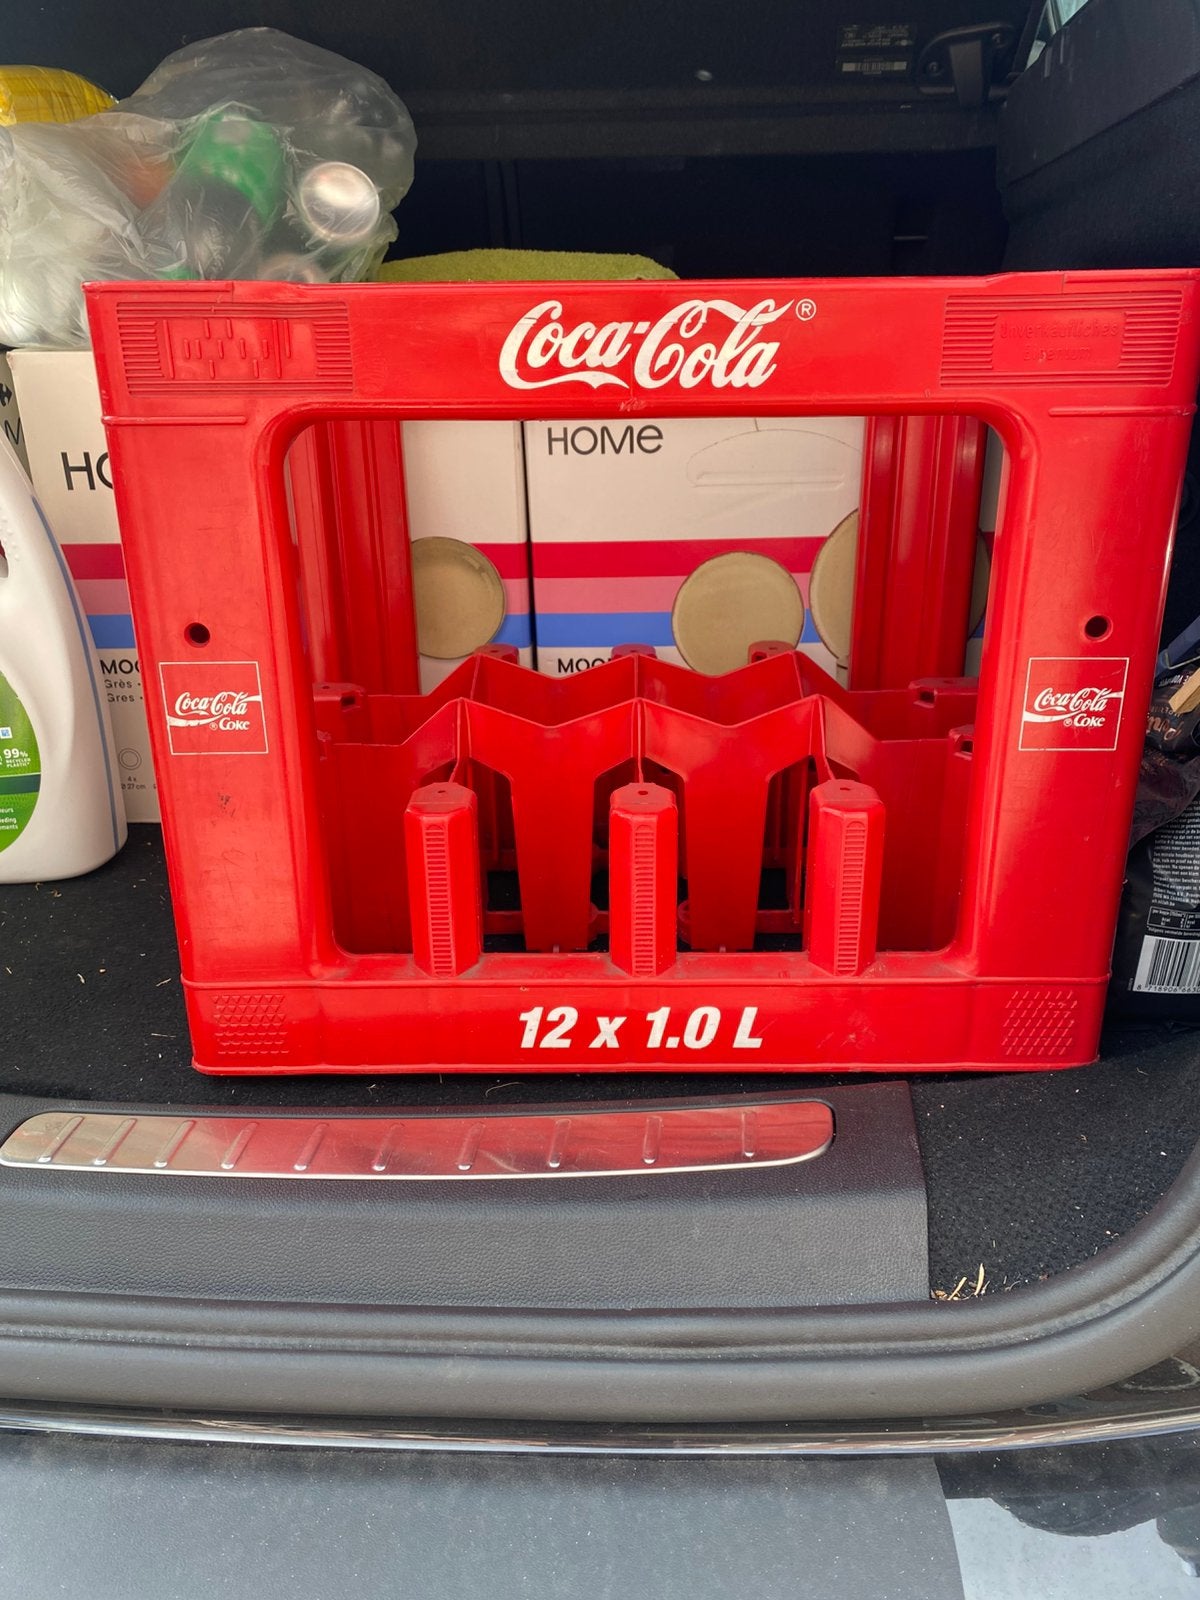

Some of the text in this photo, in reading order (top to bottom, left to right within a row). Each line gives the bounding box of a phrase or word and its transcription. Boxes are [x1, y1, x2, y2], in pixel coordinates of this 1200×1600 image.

[499, 299, 794, 389] Coca-Cola
[100, 659, 140, 674] MO
[175, 691, 248, 716] Coca-Cola
[1034, 687, 1112, 711] Coca-Cola
[219, 717, 250, 730] Coke
[1073, 713, 1105, 727] Coke
[3, 748, 29, 759] 99%
[519, 1006, 763, 1049] 12 x 1.0 L
